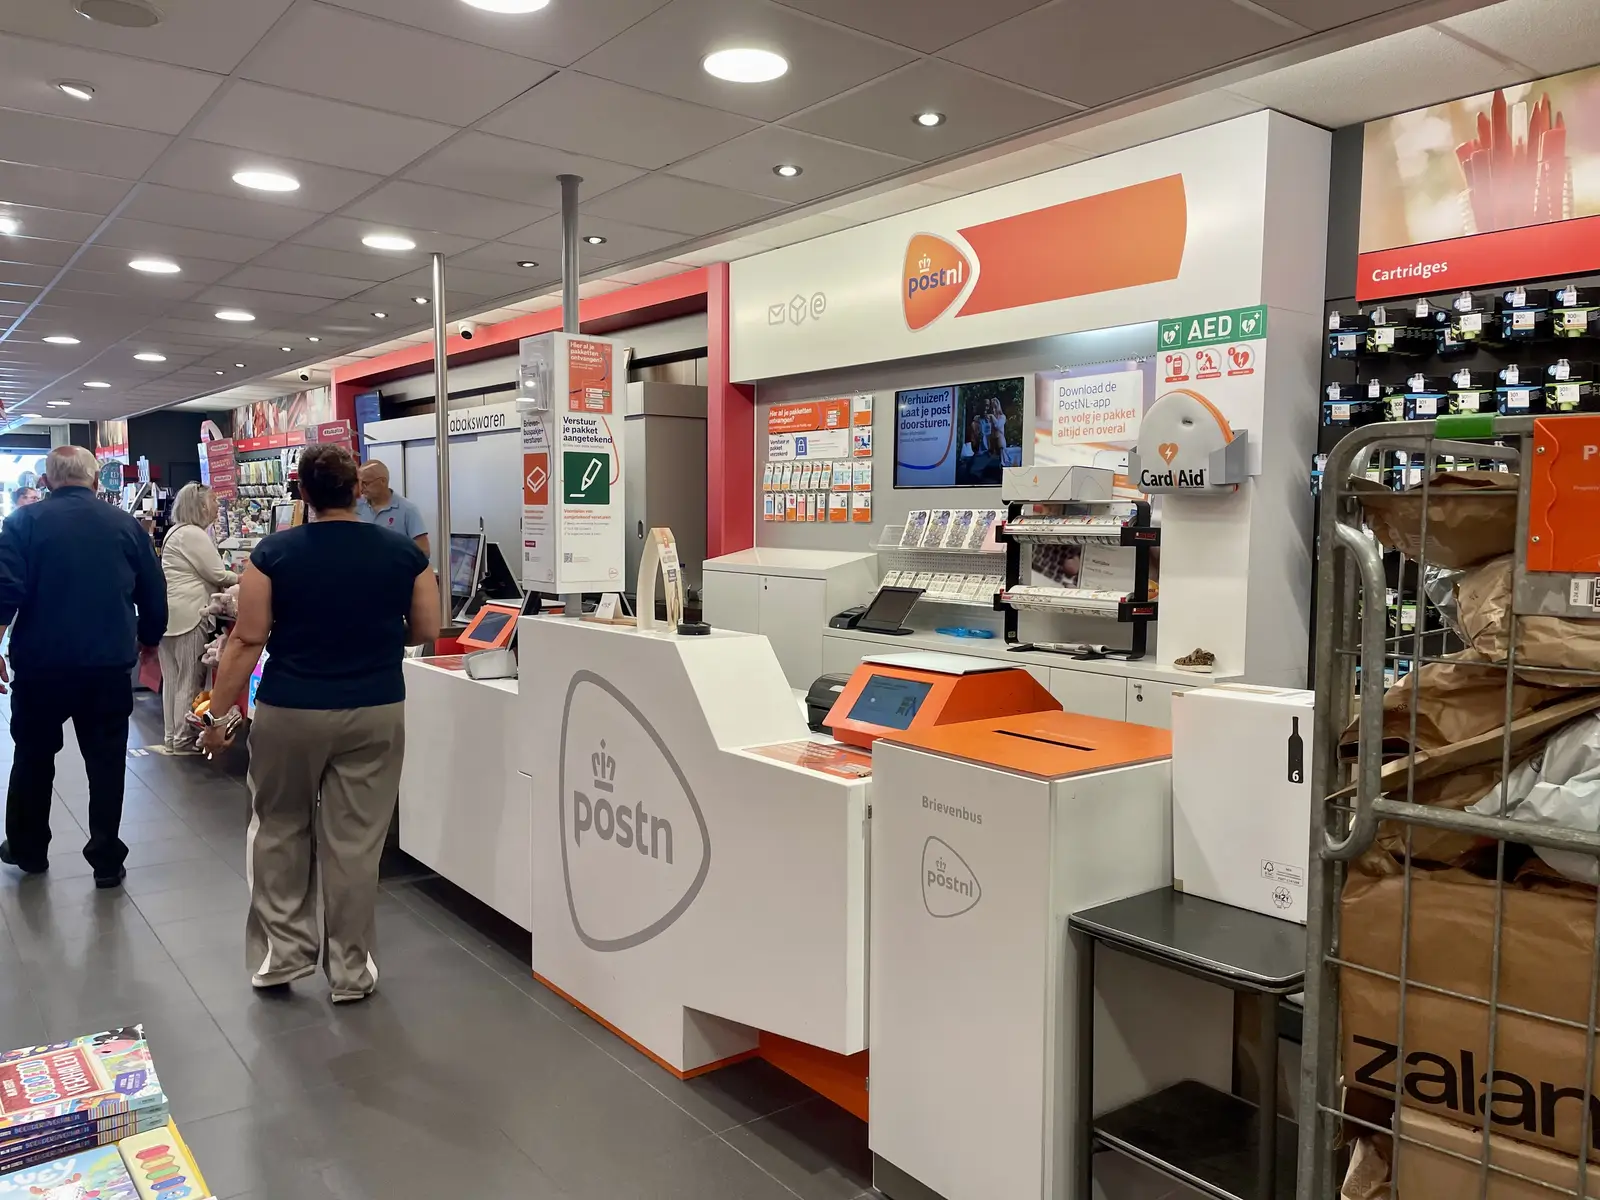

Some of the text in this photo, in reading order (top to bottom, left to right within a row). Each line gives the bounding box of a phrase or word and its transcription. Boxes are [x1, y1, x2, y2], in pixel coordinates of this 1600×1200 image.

[1371, 260, 1449, 283] Cartridges
[908, 260, 963, 300] postnl
[1187, 315, 1232, 341] AED
[570, 355, 603, 363] ontvangen?
[1059, 381, 1117, 397] Download de
[901, 391, 950, 405] Verhuizen?
[1059, 398, 1111, 410] PostNL-app
[789, 407, 812, 415] pakketten
[901, 404, 951, 418] Laat je post
[1058, 408, 1136, 425] en volg je pakket
[448, 409, 505, 433] abakswaren
[563, 416, 597, 426] Verstuur
[769, 416, 795, 424] ontvangen?
[900, 418, 950, 430] doorsturen.
[562, 425, 598, 435] je pakket
[1058, 423, 1126, 439] altijd en overal
[563, 435, 613, 444] aangetekend
[1292, 770, 1300, 782] 6
[922, 795, 983, 825] Brievenbus
[574, 790, 673, 865] postn
[927, 870, 973, 898] postnl
[52, 1051, 92, 1097] VERHALEN
